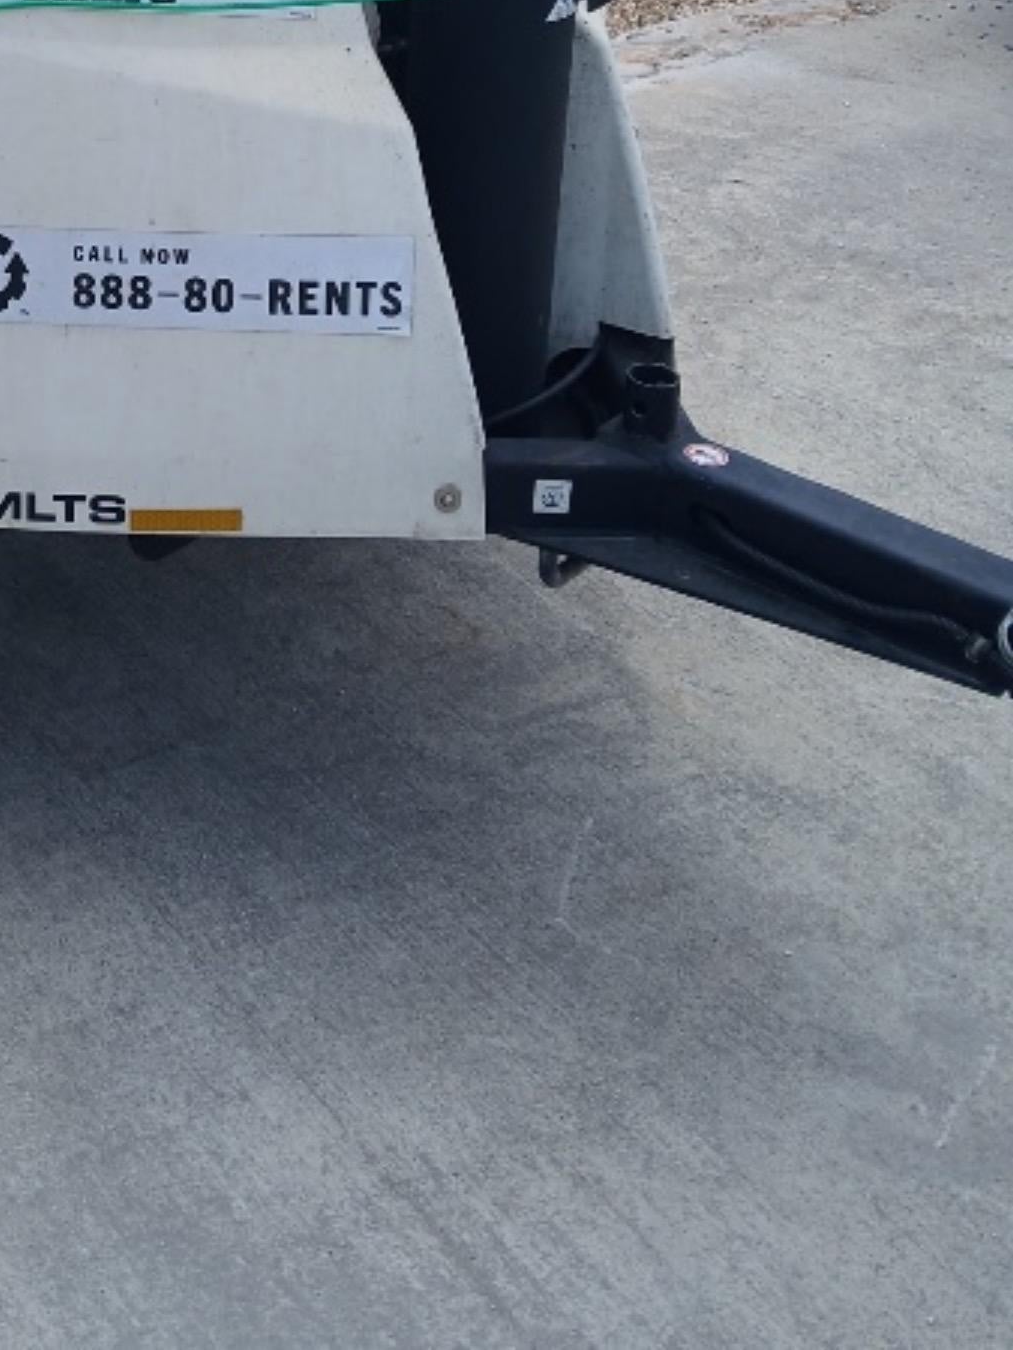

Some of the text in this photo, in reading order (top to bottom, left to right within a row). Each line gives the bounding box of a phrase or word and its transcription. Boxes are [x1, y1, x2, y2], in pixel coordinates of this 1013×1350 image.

[72, 245, 190, 266] CALL NOW
[72, 272, 404, 318] 888-80-RENTS
